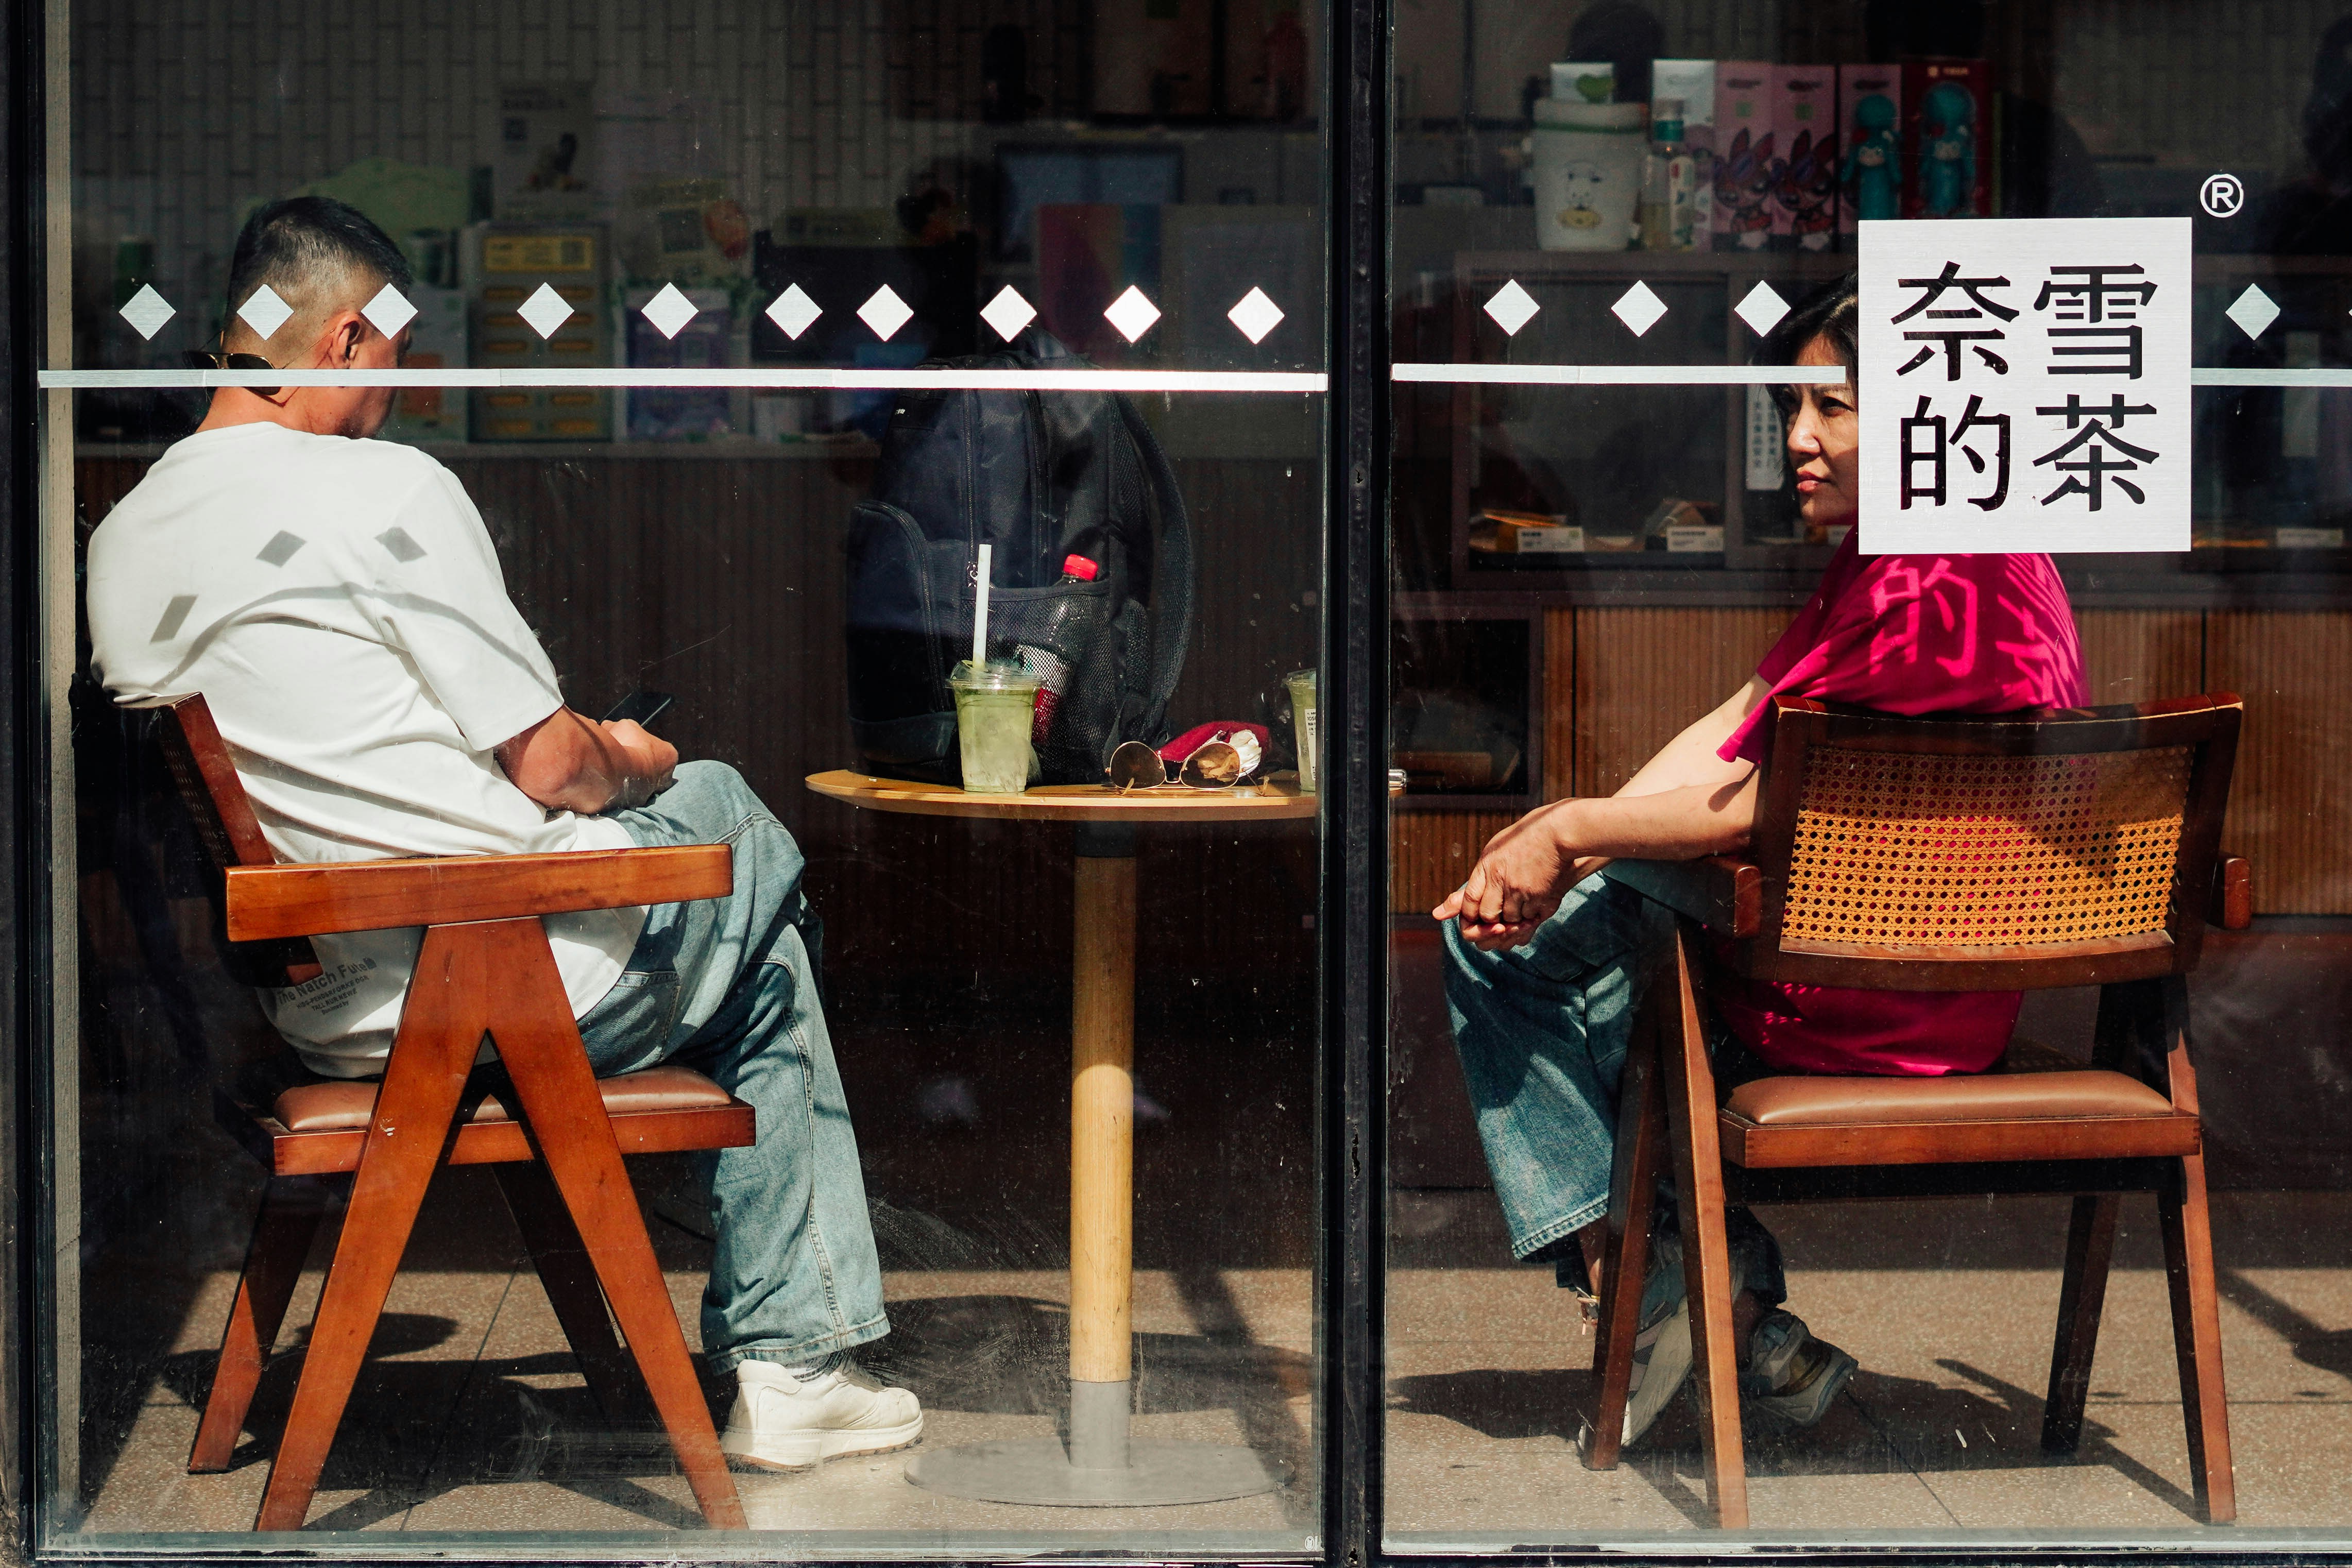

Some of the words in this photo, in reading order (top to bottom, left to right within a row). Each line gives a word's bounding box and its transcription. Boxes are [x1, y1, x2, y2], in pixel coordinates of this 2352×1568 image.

[1891, 261, 2157, 381] 奈雪
[1901, 394, 2159, 512] 的茶
[277, 990, 296, 1005] The
[295, 972, 337, 997] Natch
